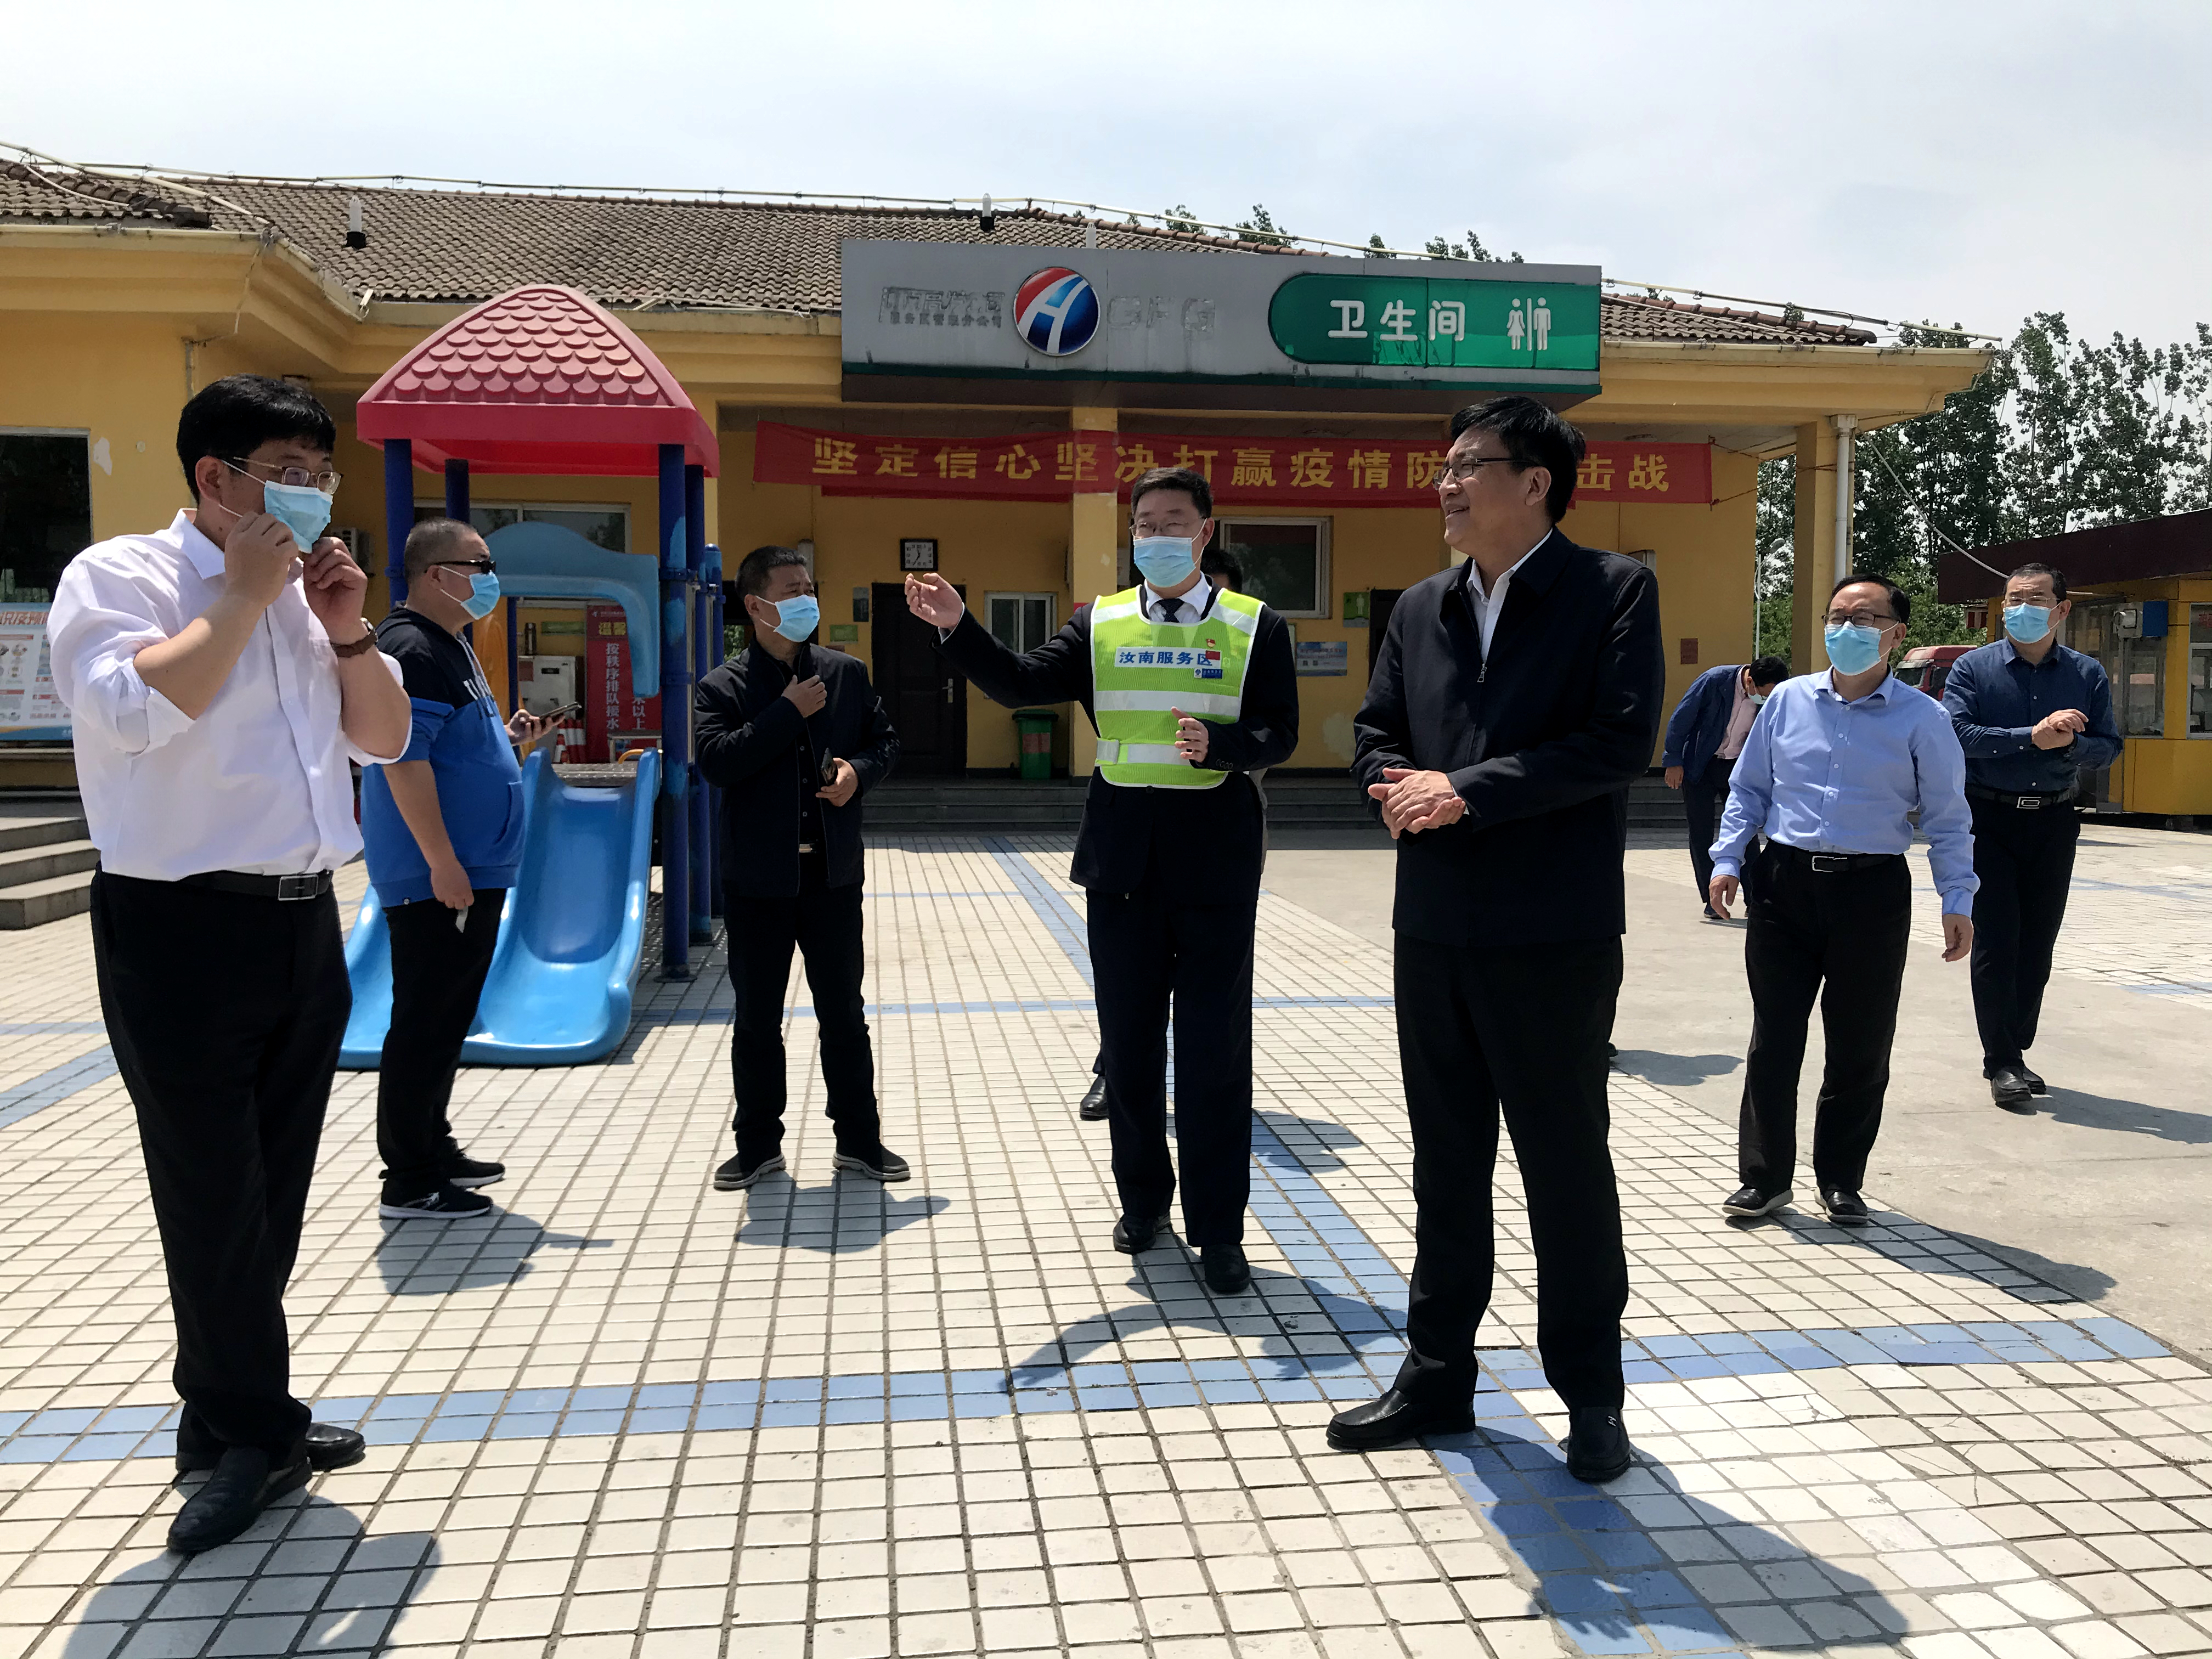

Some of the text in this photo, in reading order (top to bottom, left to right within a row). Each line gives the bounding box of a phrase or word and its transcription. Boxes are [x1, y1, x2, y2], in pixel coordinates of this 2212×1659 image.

[1328, 300, 1465, 342] 卫生间
[812, 437, 1669, 492] 坚定信心坚决打赢疫情防击战
[1119, 651, 1212, 667] 汝南服务区
